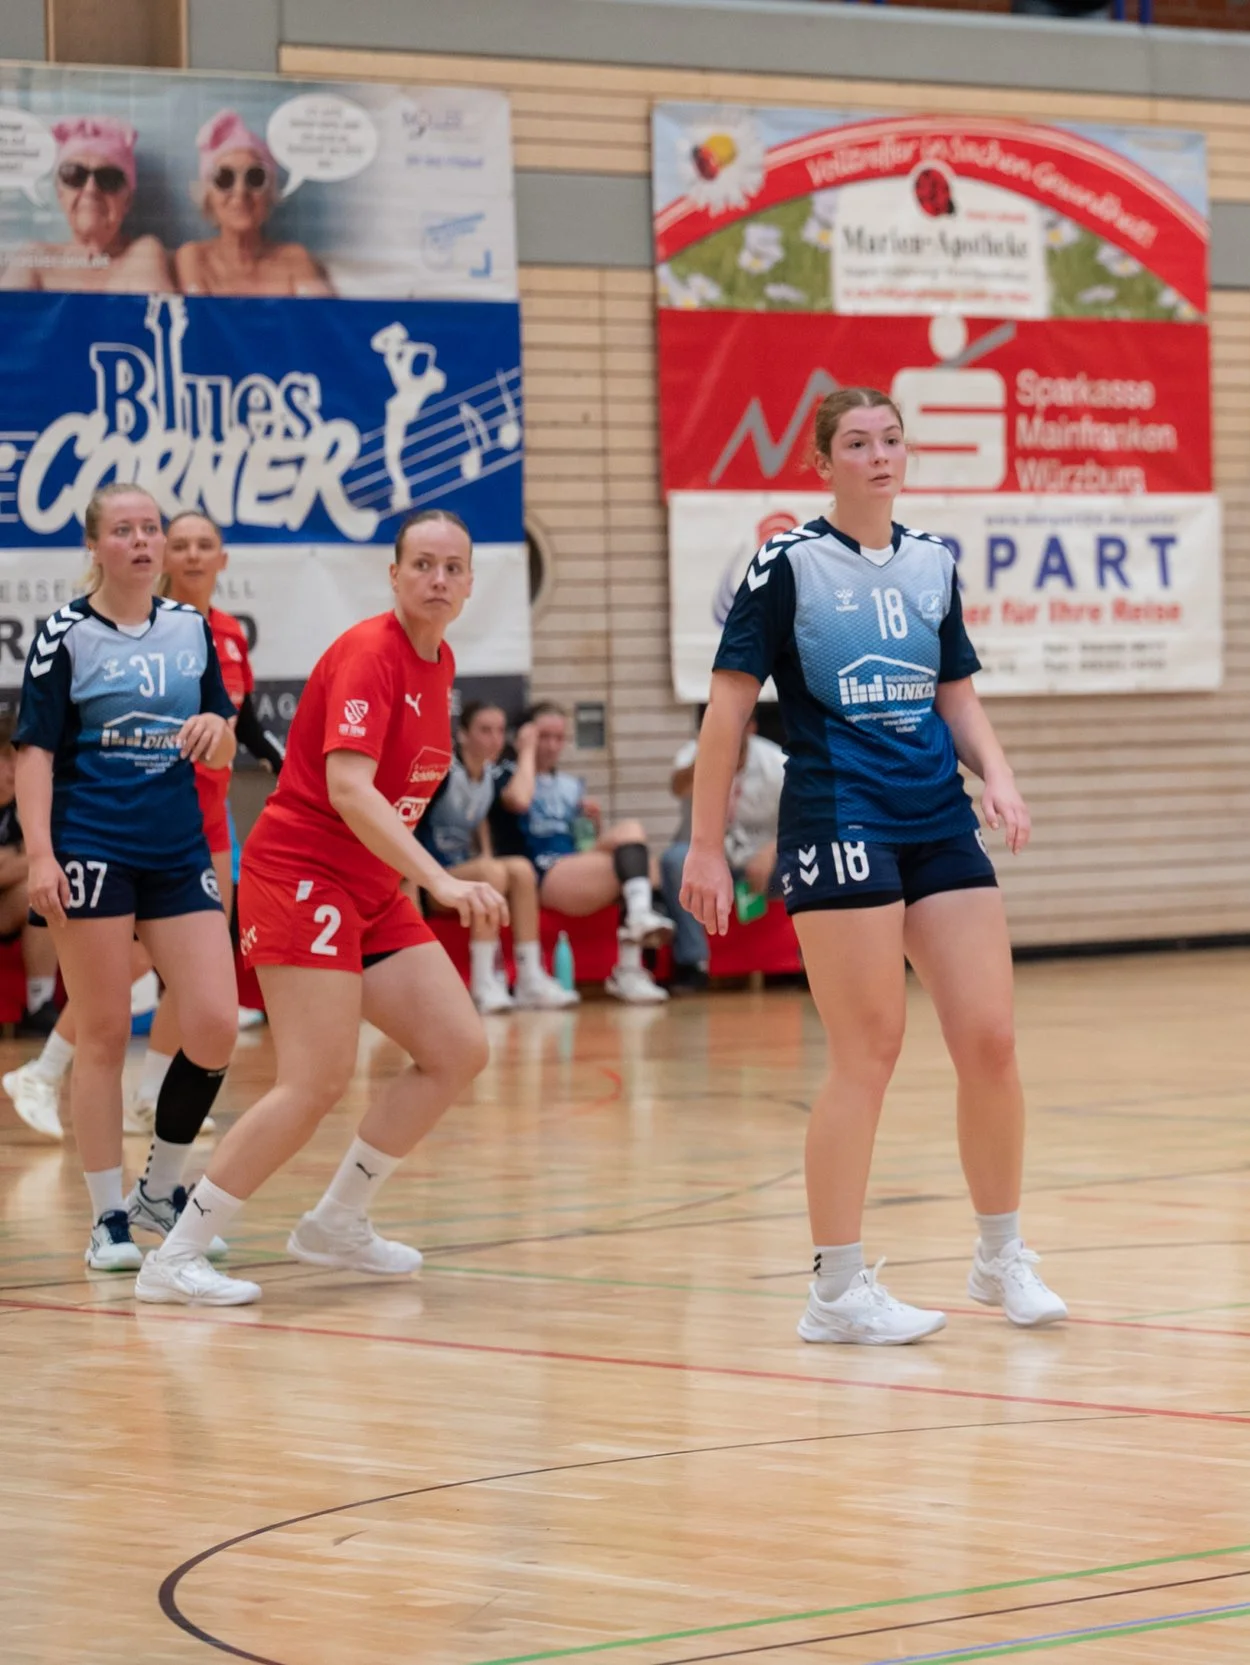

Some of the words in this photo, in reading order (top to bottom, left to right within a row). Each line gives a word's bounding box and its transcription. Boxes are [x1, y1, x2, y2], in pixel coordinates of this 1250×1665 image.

[90, 298, 322, 442] Blues
[1016, 368, 1156, 414] Sparkasse
[1015, 412, 1178, 453] Mainfranken
[18, 411, 380, 542] CORNER
[1014, 457, 1149, 494] Würzburg
[871, 587, 908, 640] 18
[129, 652, 166, 697] 37
[885, 681, 936, 701] DINKEL
[65, 860, 108, 909] 37
[831, 841, 870, 885] 18
[310, 904, 342, 956] 2
